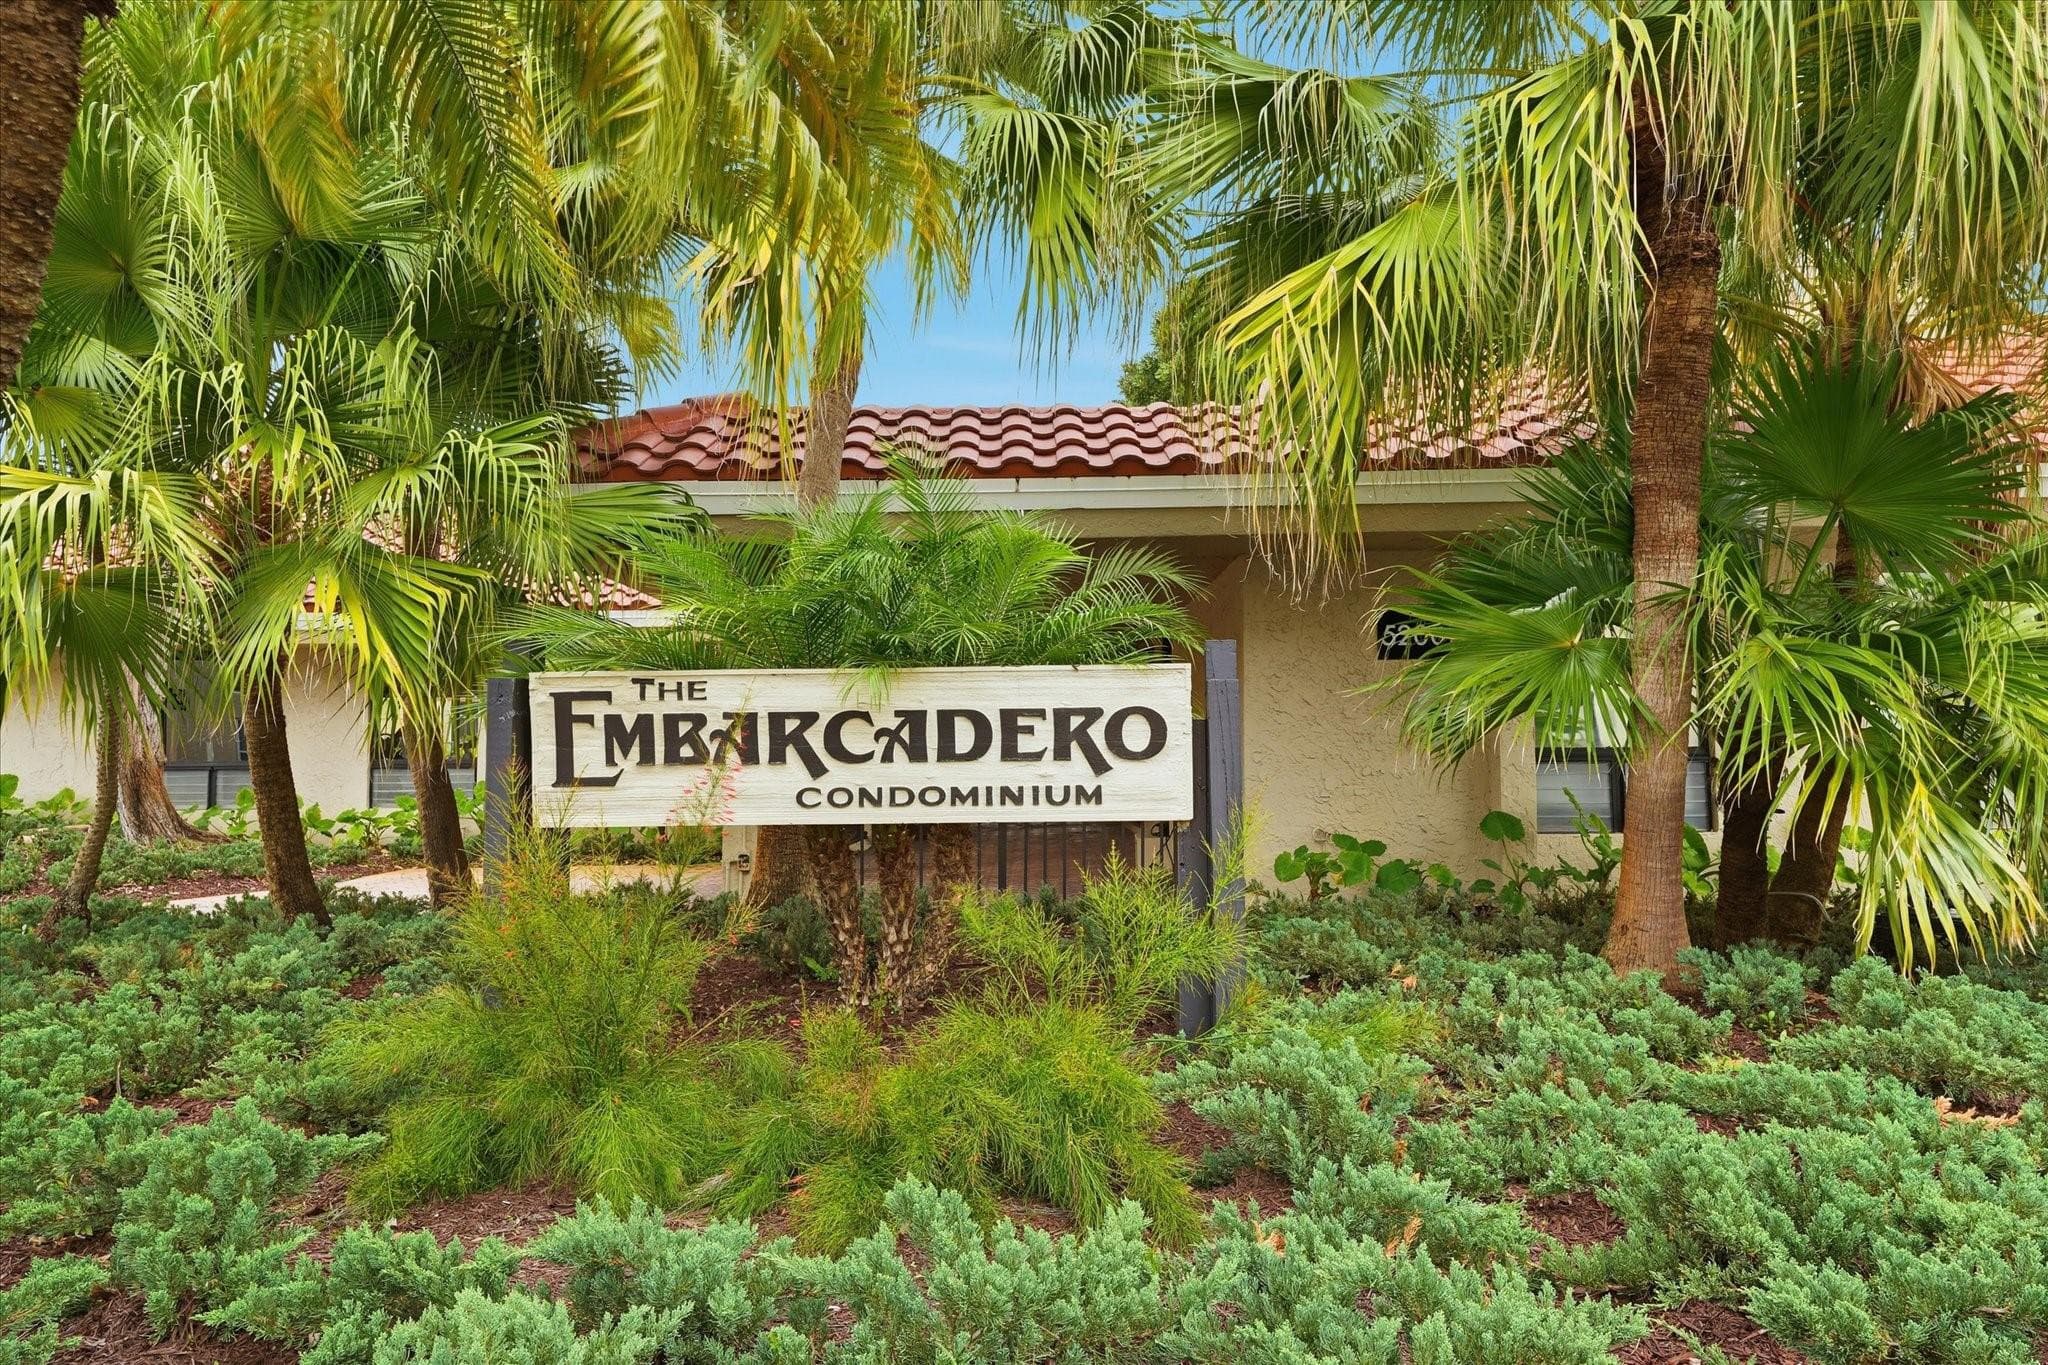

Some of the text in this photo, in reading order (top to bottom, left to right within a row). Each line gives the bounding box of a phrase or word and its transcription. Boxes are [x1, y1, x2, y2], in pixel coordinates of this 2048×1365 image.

[631, 677, 708, 701] THE
[549, 691, 1168, 788] EMBARCADERO
[795, 784, 1103, 809] CONDOMINIUM
